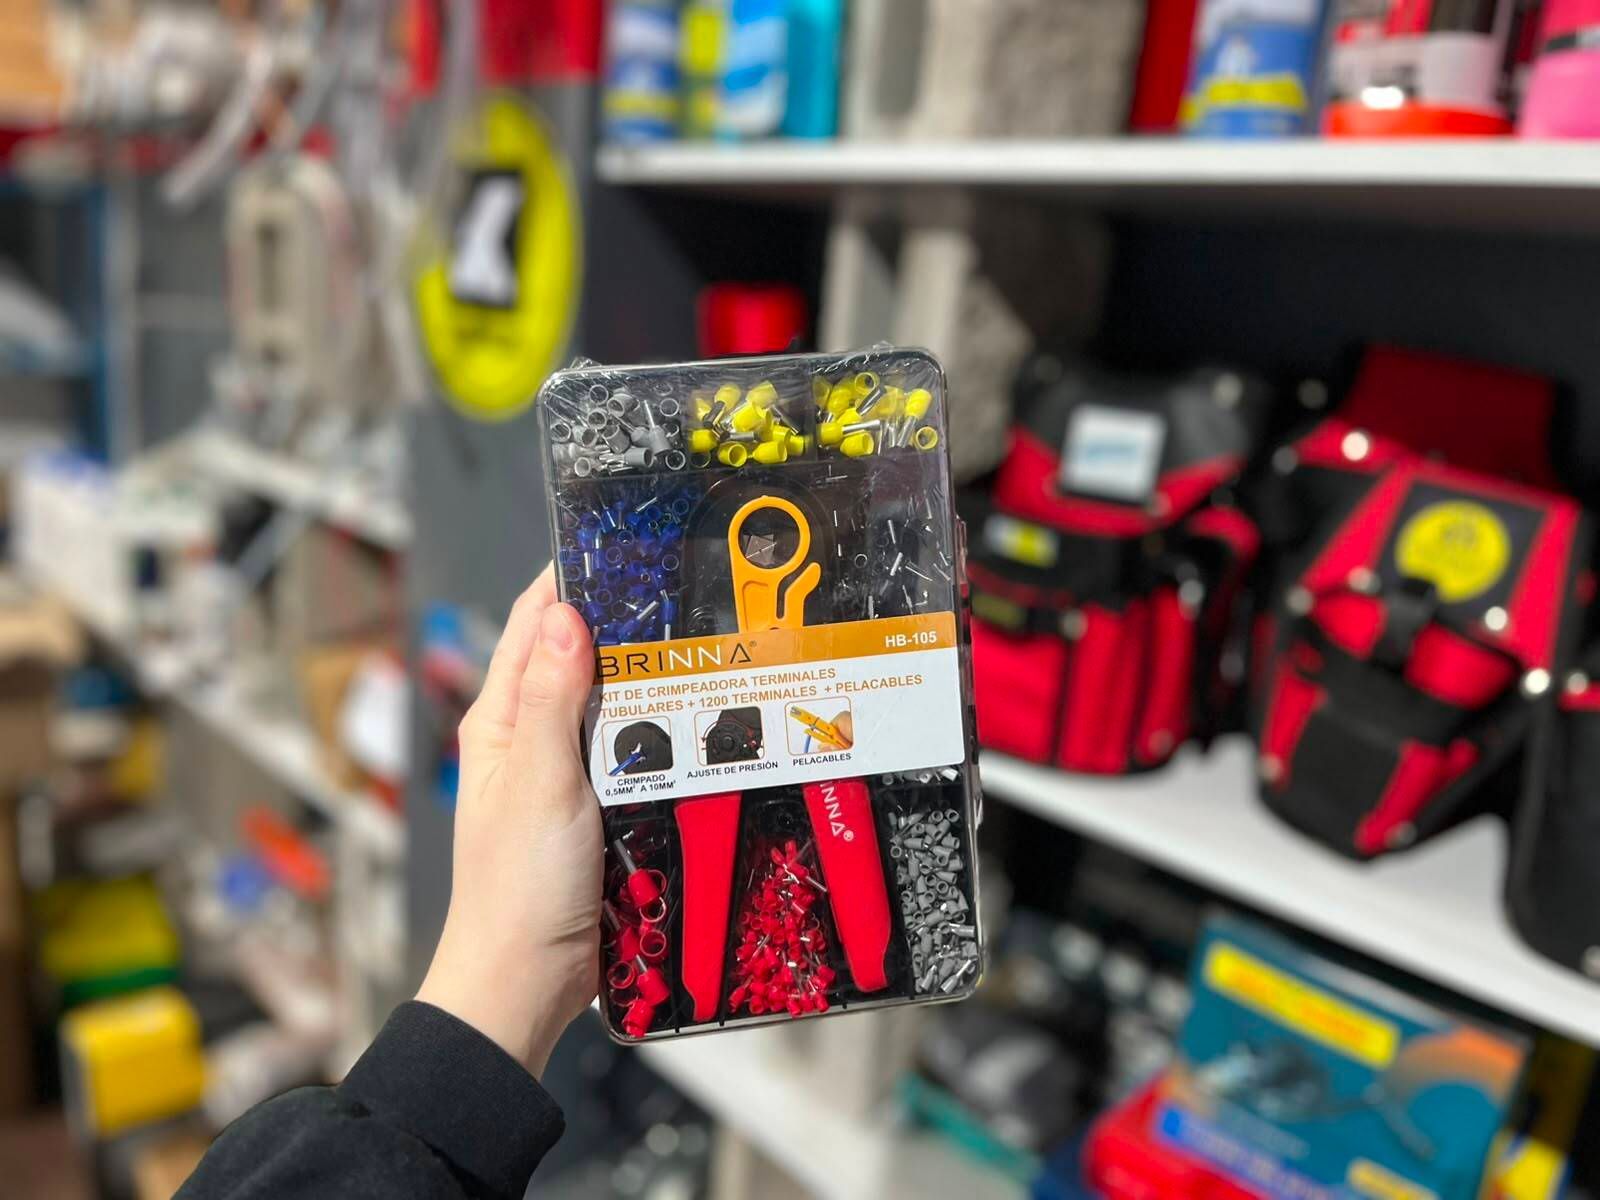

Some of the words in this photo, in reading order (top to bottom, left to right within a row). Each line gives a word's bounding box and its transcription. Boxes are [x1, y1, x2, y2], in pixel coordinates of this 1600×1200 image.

[885, 631, 937, 648] HB-105
[600, 690, 621, 703] KIT
[624, 689, 644, 701] DE
[647, 677, 748, 698] CRIMPEADORA
[751, 668, 836, 687] TERMINALES
[600, 700, 684, 719] TUBULARES
[687, 700, 695, 708] +
[701, 695, 728, 708] 1200
[732, 685, 817, 705] TERMINALES
[824, 685, 832, 693] +
[835, 674, 923, 693] PELACABLES
[792, 752, 852, 767] PELACABLES
[687, 767, 722, 779] AJUSTE
[724, 765, 737, 775] DE
[739, 761, 778, 773] PRESIÓN
[617, 774, 666, 787] CRIMPADO
[640, 783, 647, 792] A
